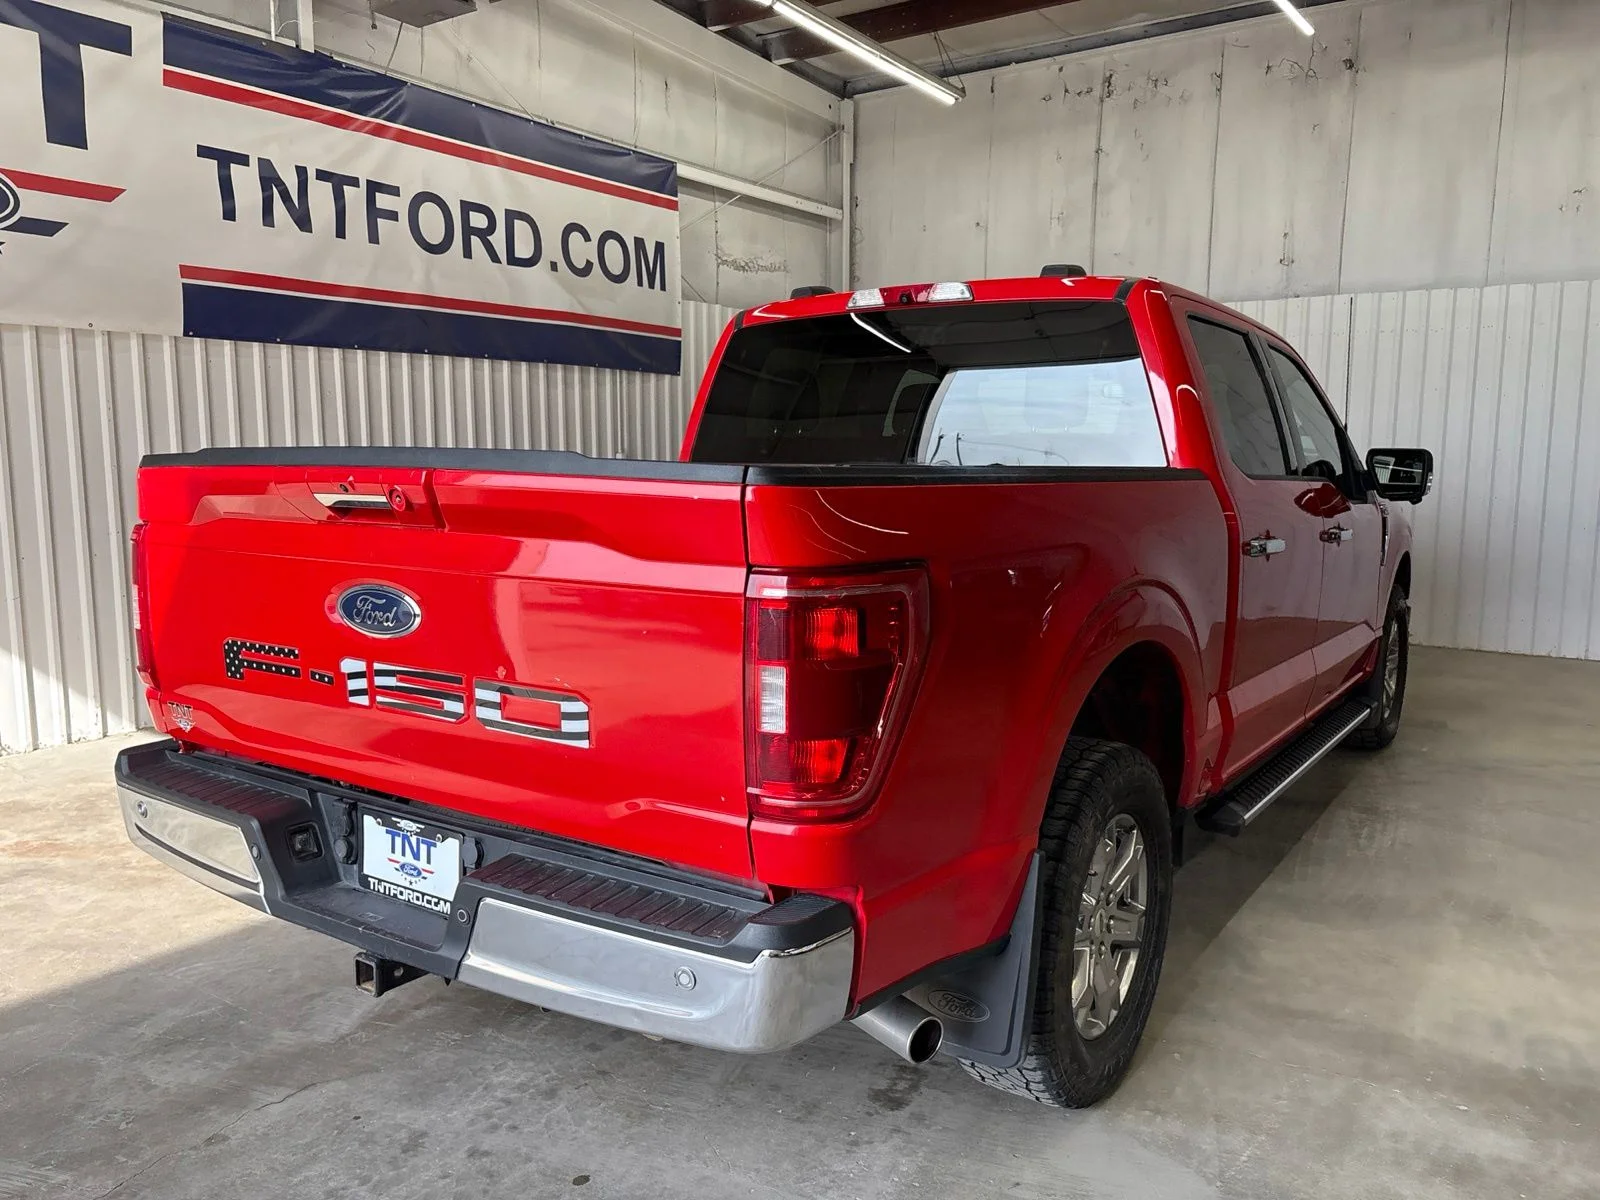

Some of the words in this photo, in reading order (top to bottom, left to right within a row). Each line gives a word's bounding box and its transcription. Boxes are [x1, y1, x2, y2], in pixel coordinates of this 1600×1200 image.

[197, 144, 667, 292] TNTFORD.COM
[353, 595, 397, 627] Ford
[223, 638, 590, 749] F-150
[386, 829, 437, 865] TNT
[368, 877, 451, 914] TNTFORD.COM
[939, 993, 975, 1017] Ford
